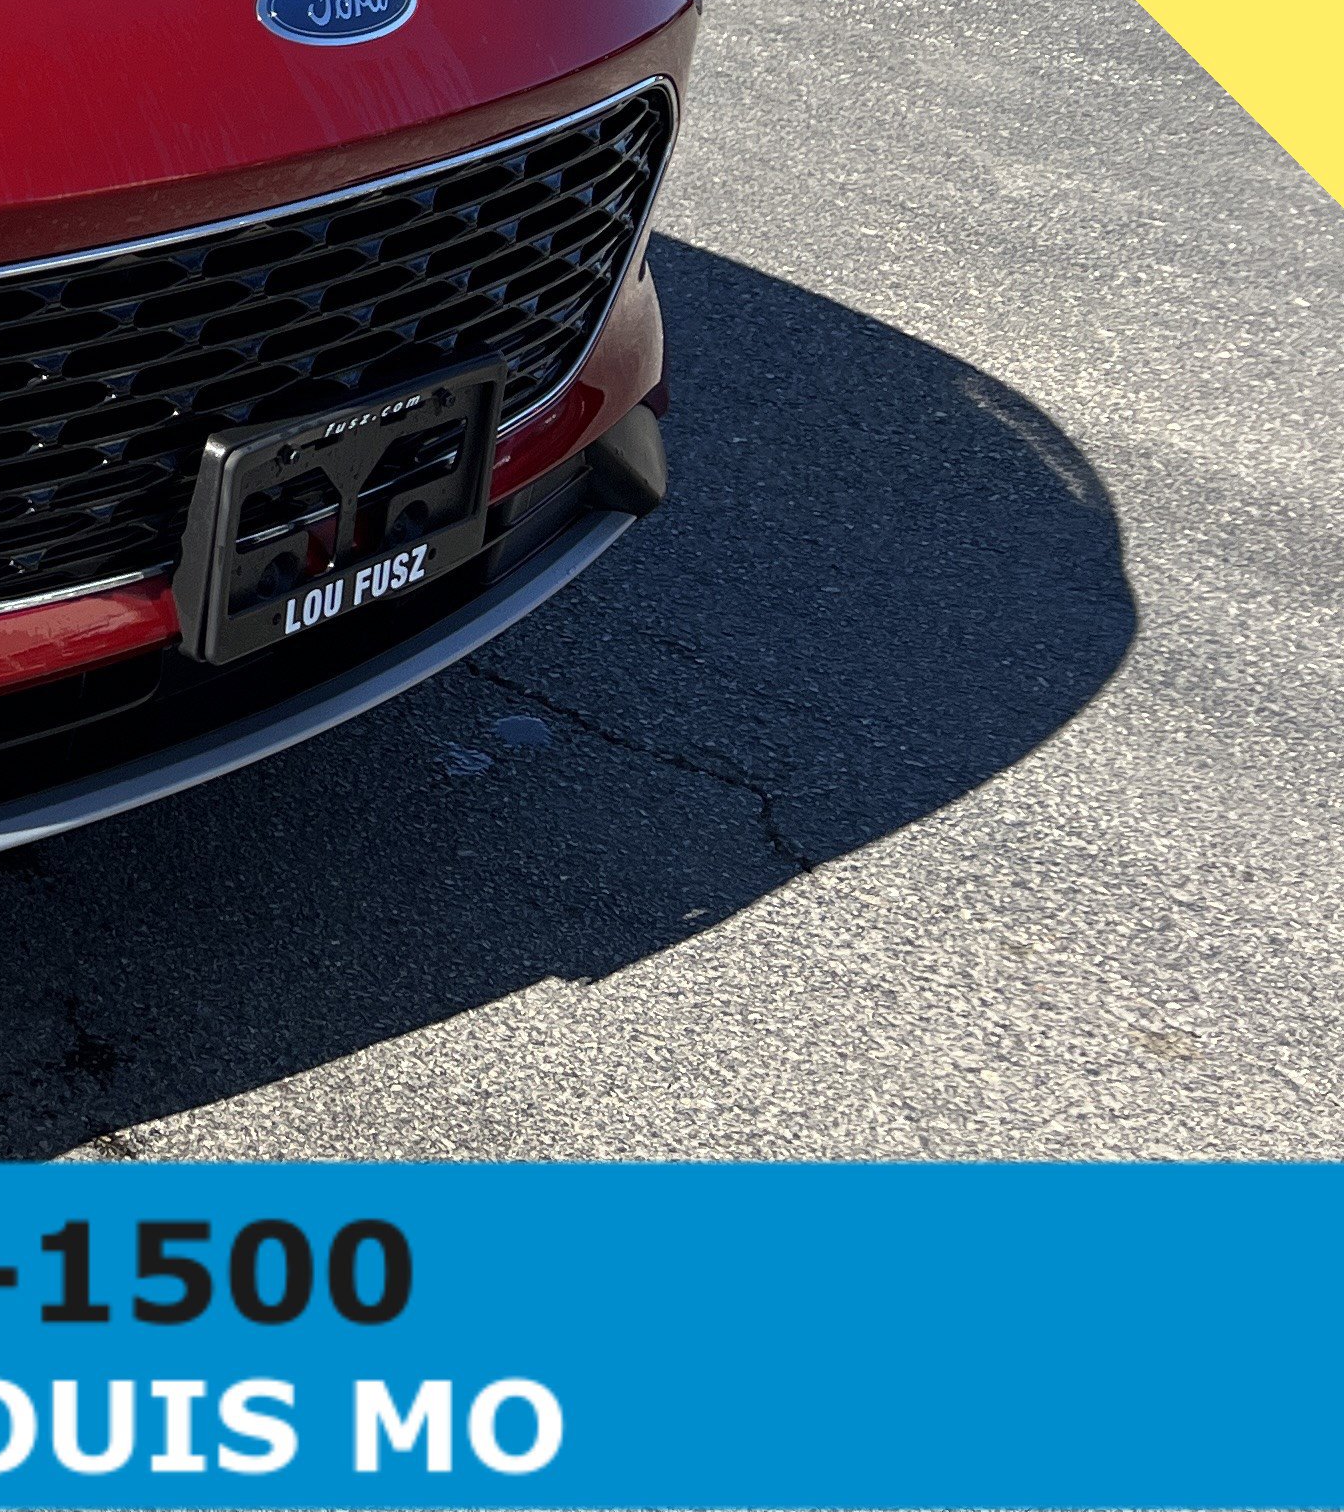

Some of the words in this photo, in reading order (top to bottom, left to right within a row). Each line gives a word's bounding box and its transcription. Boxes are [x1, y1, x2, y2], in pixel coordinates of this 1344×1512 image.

[324, 394, 421, 438] fusz.com
[285, 579, 344, 635] LOU
[353, 544, 428, 606] FUSZ
